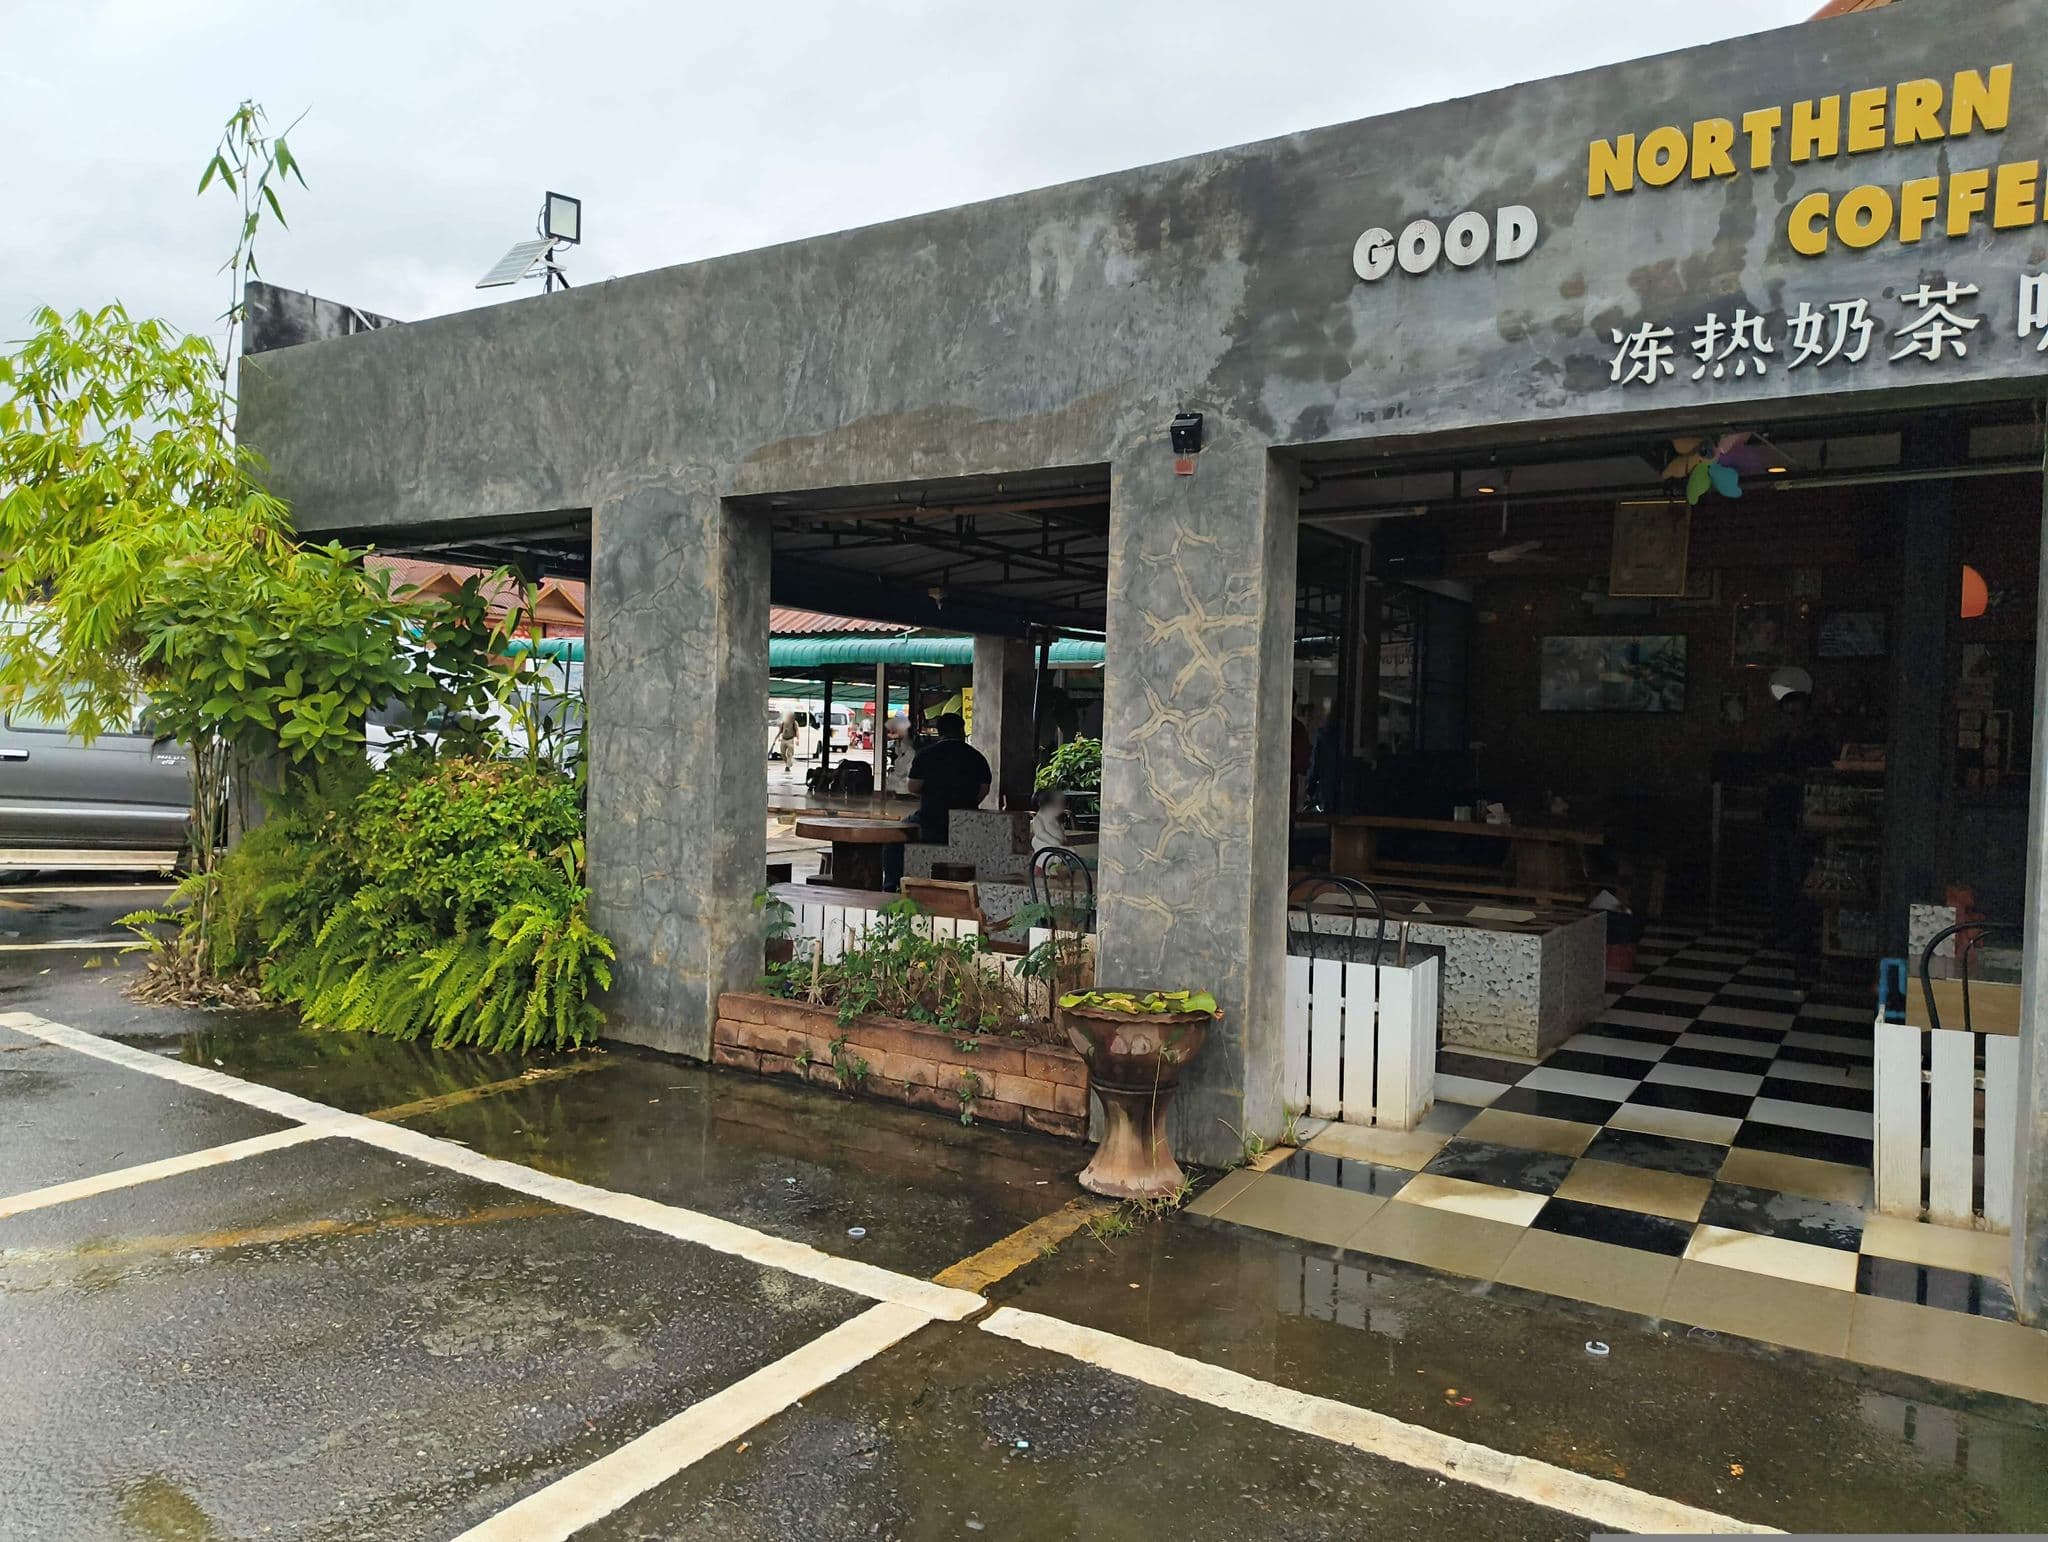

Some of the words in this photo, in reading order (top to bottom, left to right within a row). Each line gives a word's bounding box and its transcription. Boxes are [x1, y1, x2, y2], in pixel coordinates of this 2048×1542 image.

[1588, 63, 2013, 197] NORTHERN
[1353, 205, 1538, 281] GOOD
[1788, 160, 2048, 256] COFFE
